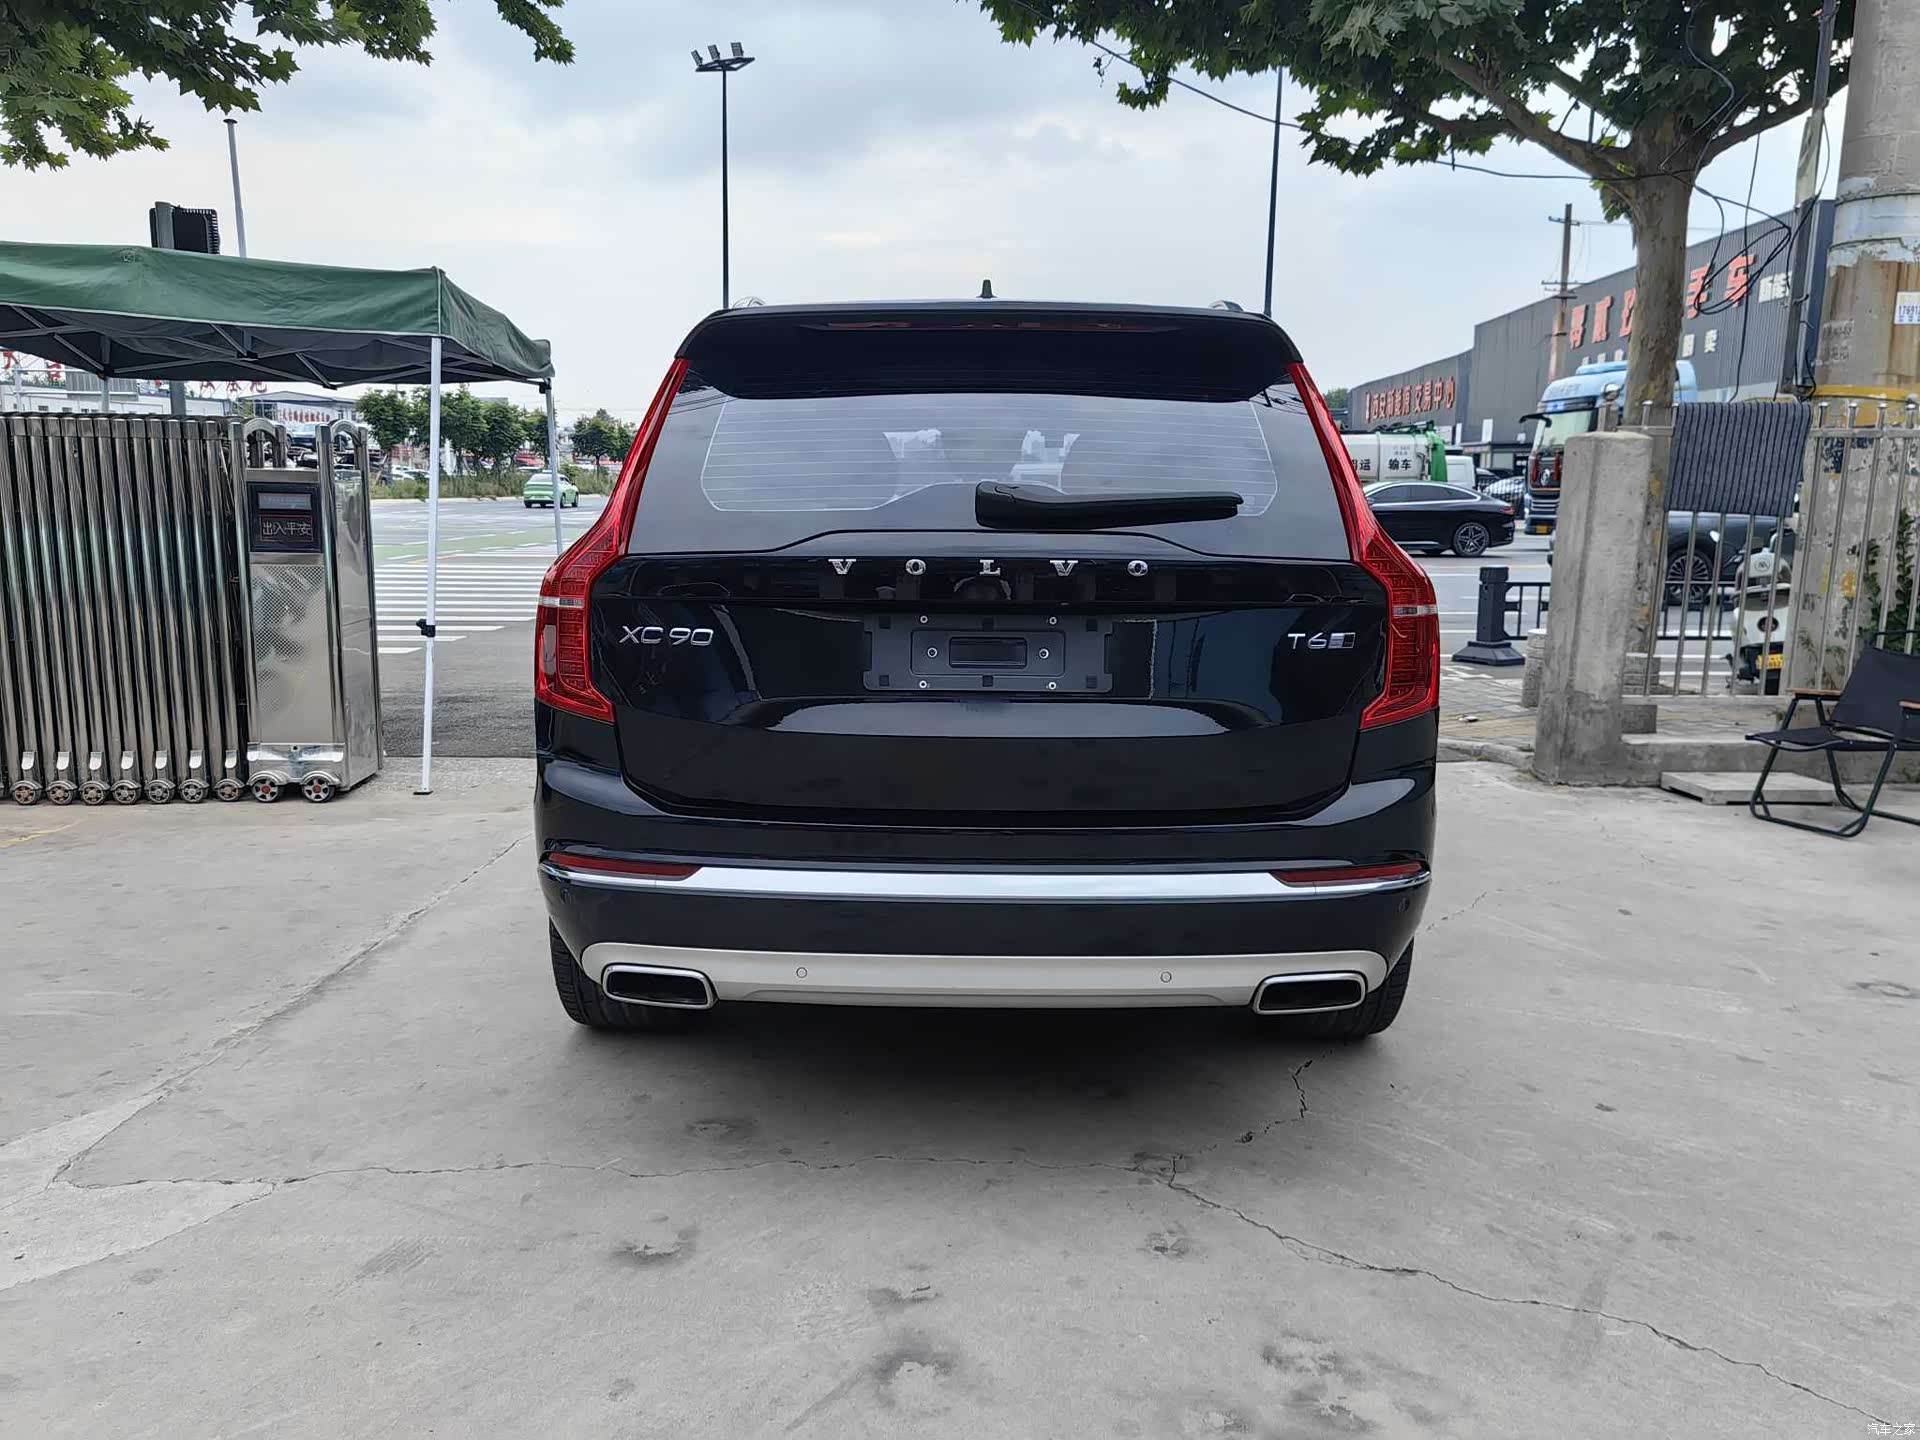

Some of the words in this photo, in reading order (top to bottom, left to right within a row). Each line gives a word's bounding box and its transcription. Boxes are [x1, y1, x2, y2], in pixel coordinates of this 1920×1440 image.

[262, 520, 313, 536] 出入平安
[828, 558, 1149, 577] VOLVO
